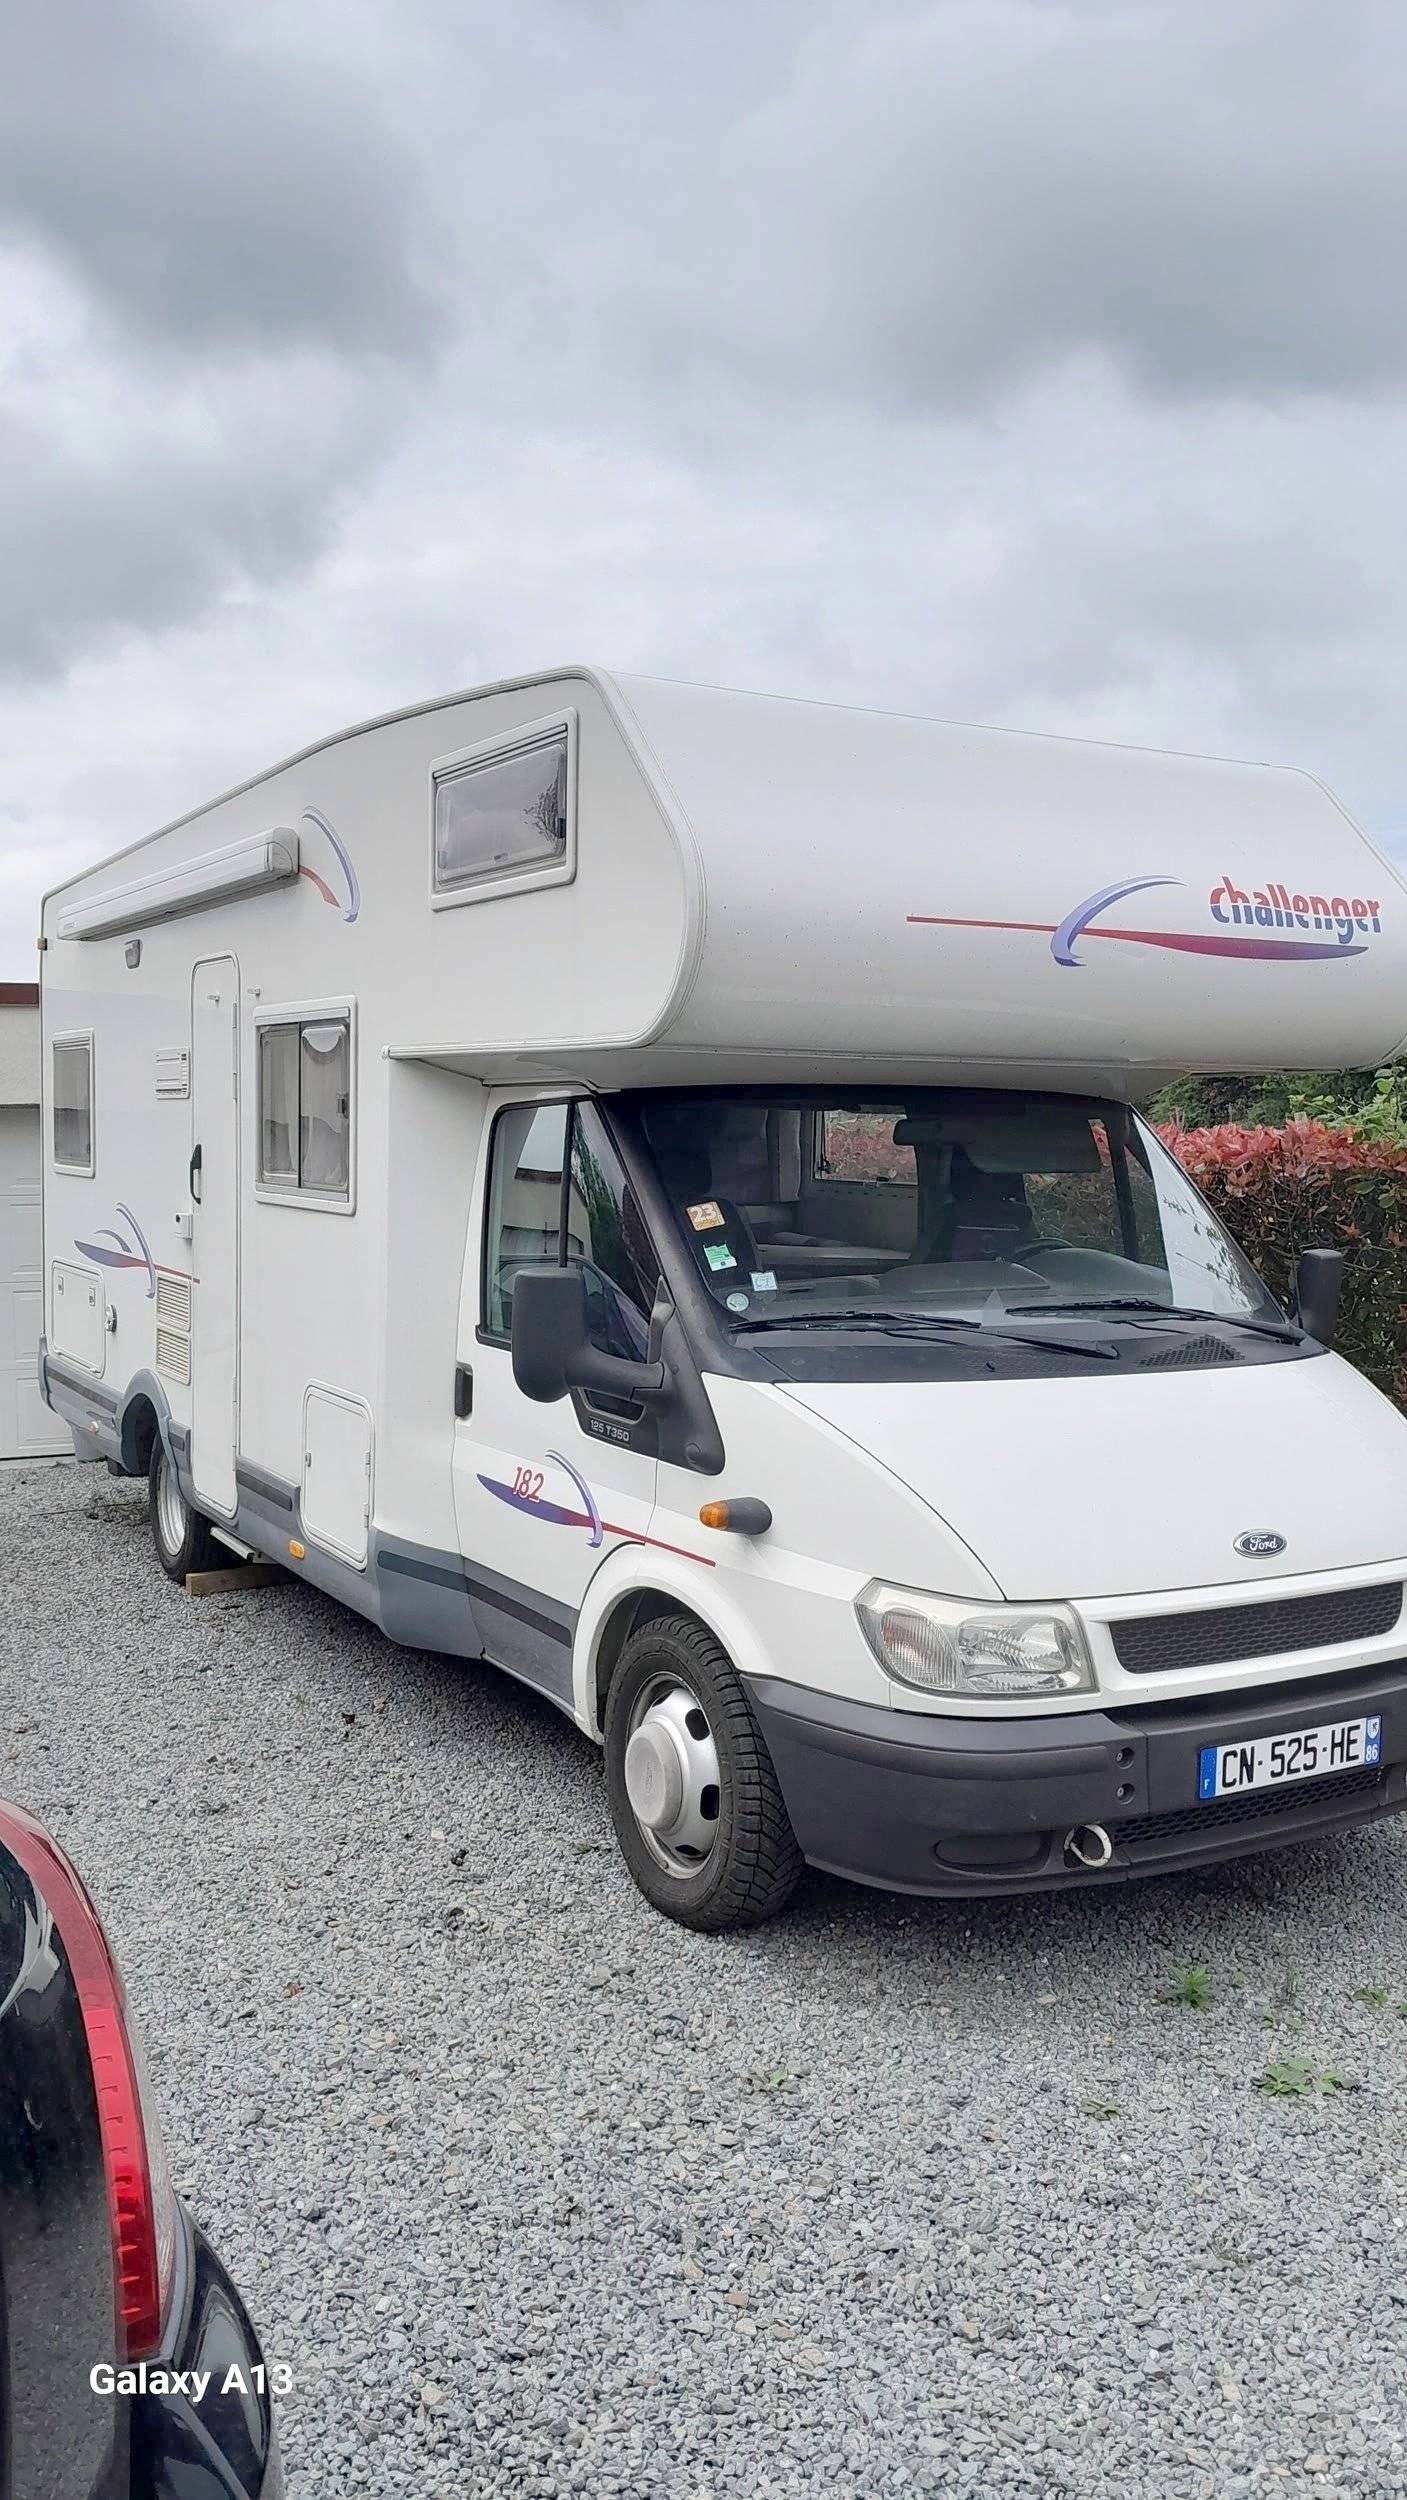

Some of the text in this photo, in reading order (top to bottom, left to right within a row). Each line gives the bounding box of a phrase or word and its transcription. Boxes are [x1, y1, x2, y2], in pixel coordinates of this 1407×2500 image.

[1209, 875, 1382, 945] challenger
[690, 1204, 717, 1223] 23
[590, 1419, 630, 1442] 125 T350
[512, 1466, 545, 1502] 182
[1249, 1535, 1278, 1551] Ford
[1365, 1743, 1379, 1762] 86
[1203, 1778, 1210, 1791] F
